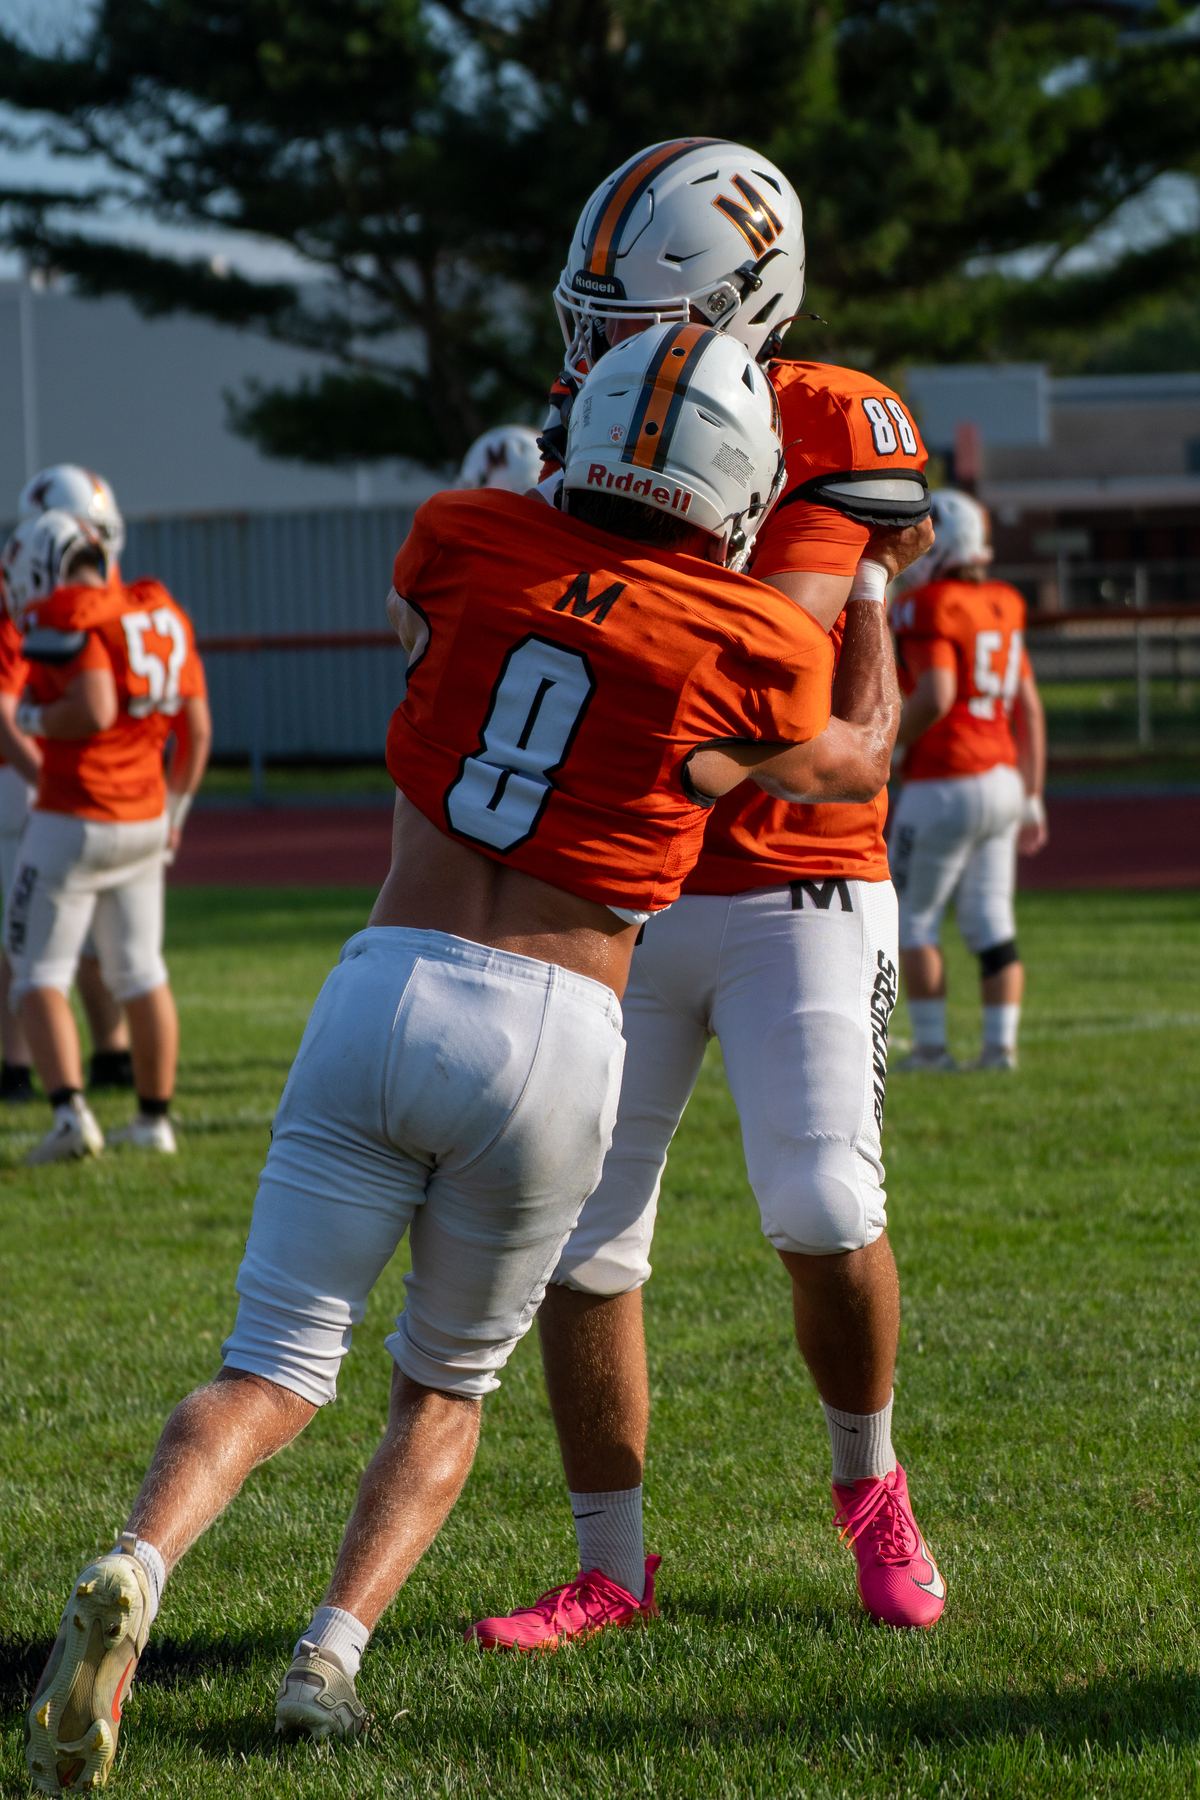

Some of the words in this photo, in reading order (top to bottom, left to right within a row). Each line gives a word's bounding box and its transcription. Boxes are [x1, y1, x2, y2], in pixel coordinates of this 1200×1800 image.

[711, 173, 784, 260] M
[575, 276, 616, 294] Riddell
[862, 397, 917, 456] 88
[587, 463, 694, 516] Riddell
[553, 571, 628, 626] M
[443, 631, 598, 857] 8
[788, 879, 854, 913] M
